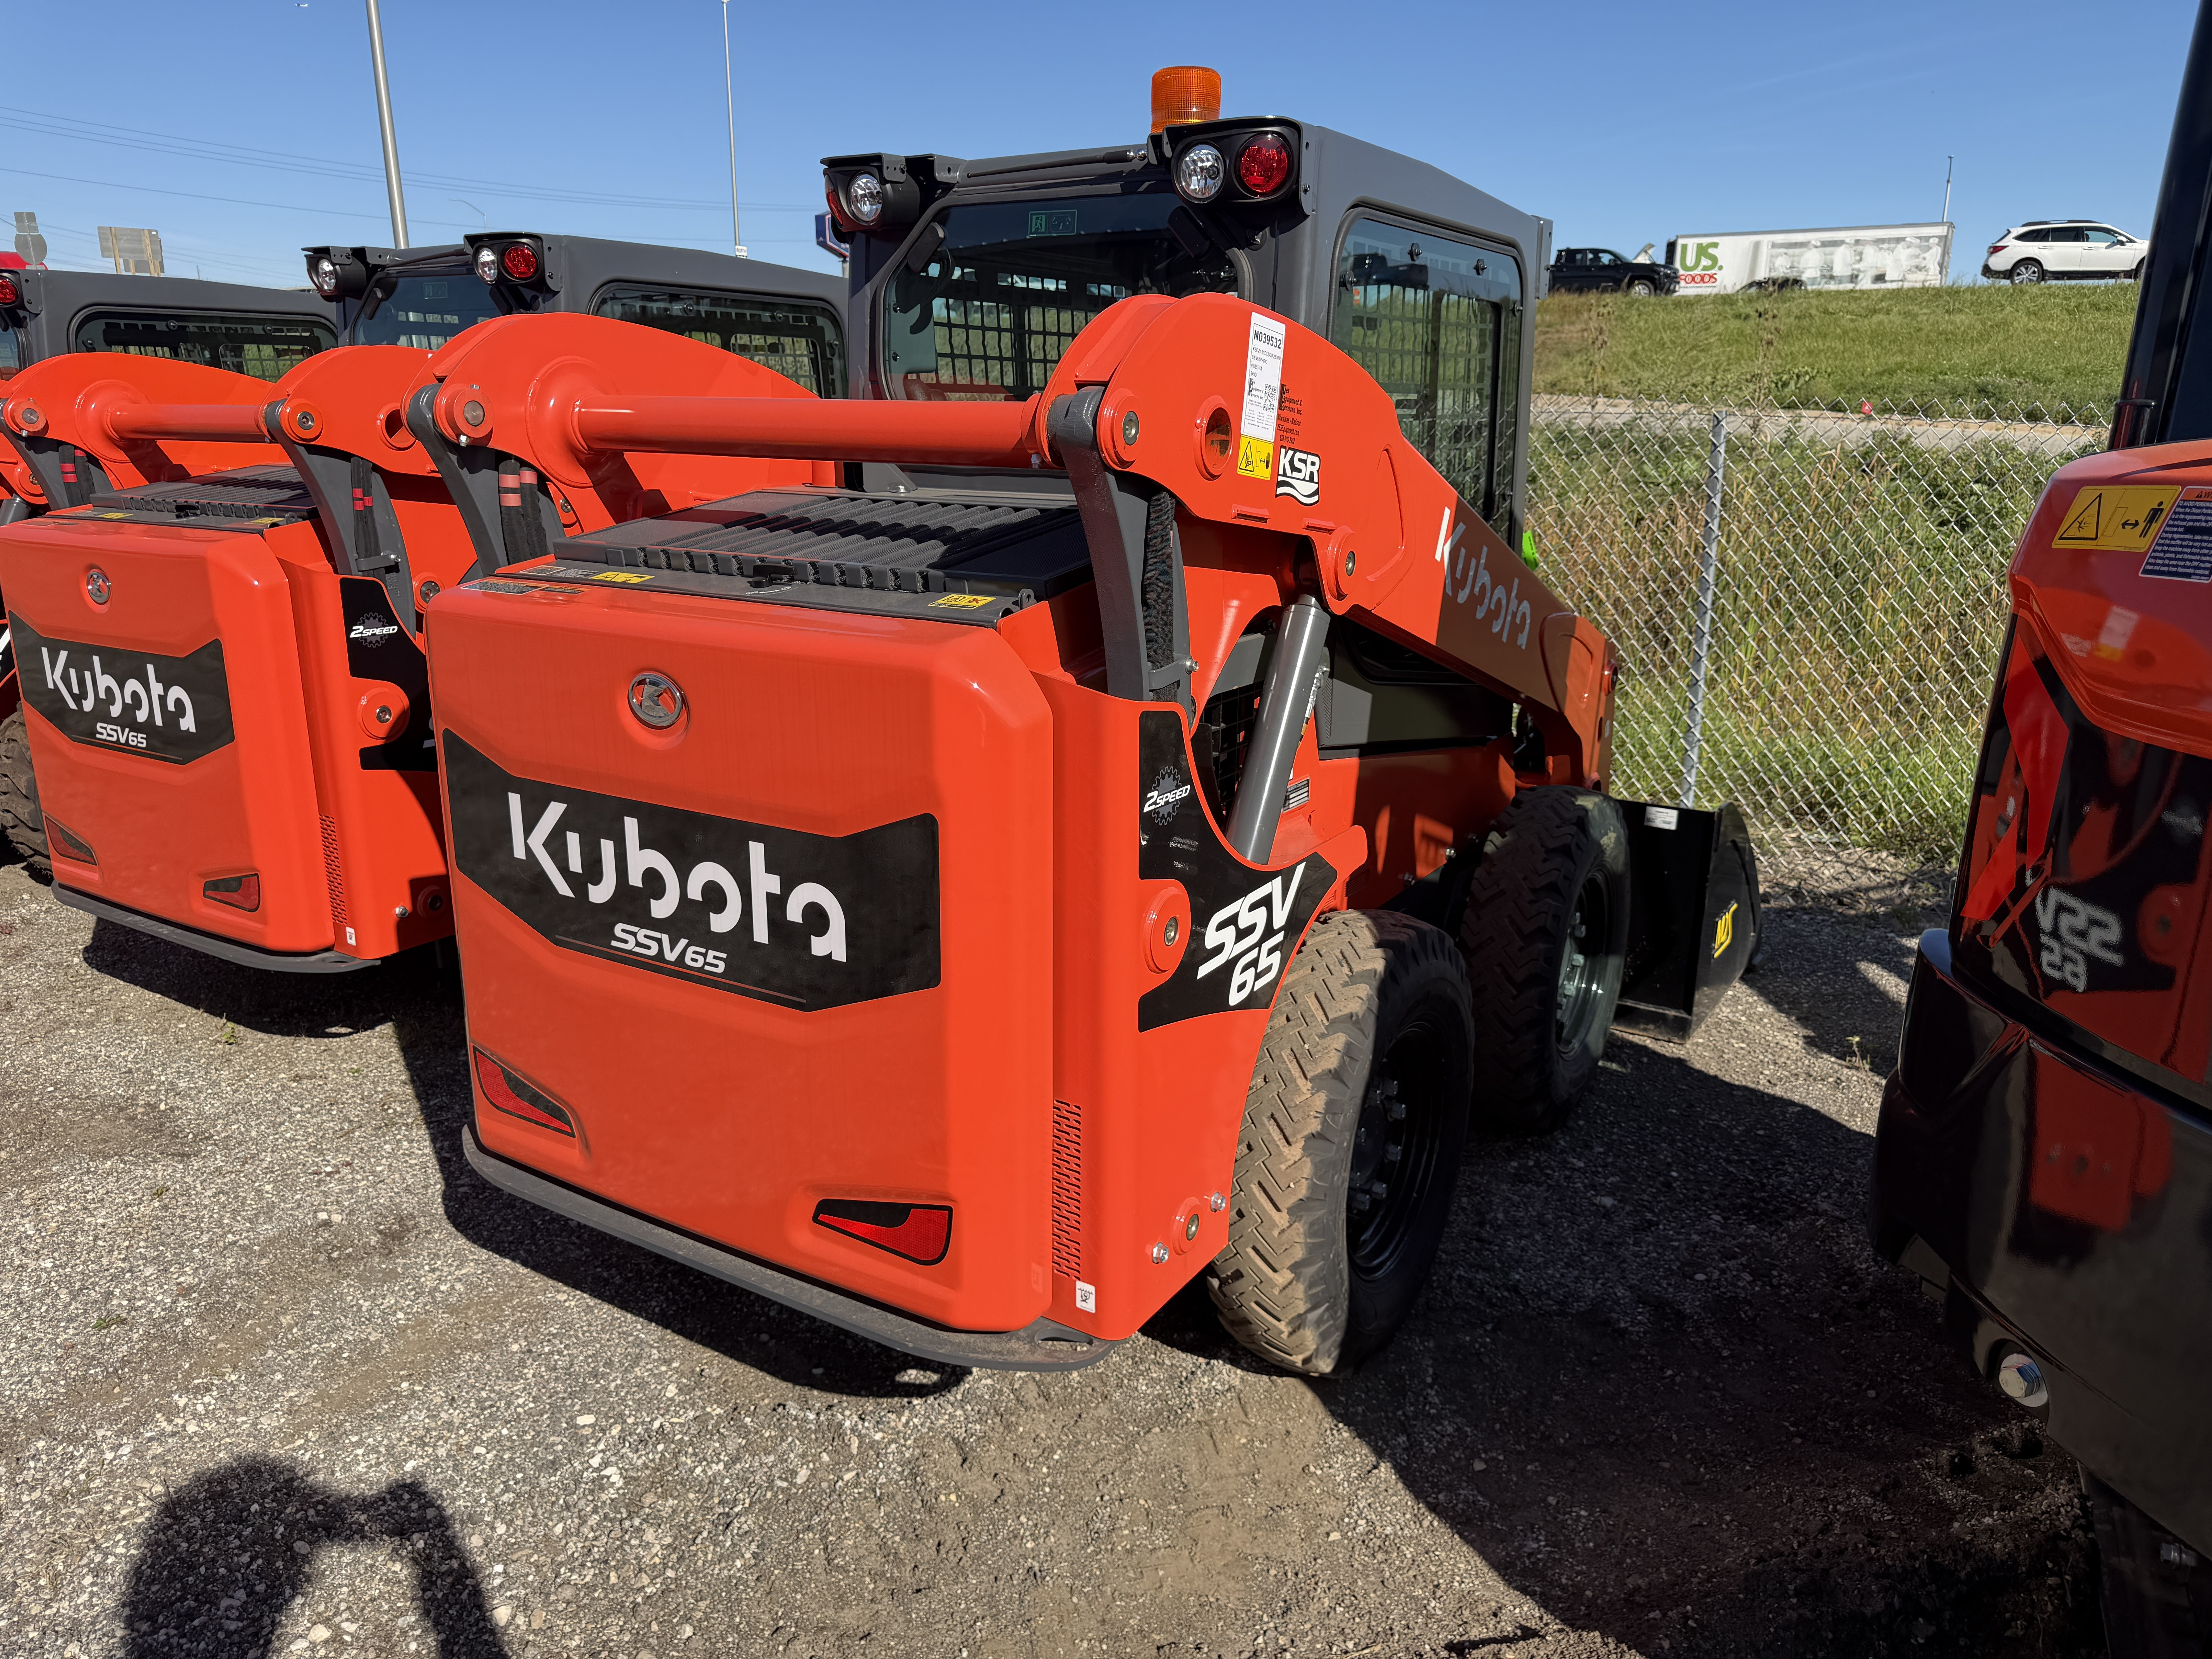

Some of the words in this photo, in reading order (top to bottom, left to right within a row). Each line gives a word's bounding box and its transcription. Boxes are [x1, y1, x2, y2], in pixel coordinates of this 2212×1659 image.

[1679, 273, 1717, 284] FOODS
[1254, 330, 1281, 349] N039532
[1278, 448, 1320, 483] KSR
[1435, 507, 1530, 649] Kubota
[350, 625, 398, 638] 2SPEED
[41, 647, 196, 733] Kubota
[96, 722, 147, 748] SSV65
[1143, 785, 1190, 813] 2SPEED
[508, 792, 847, 962] Kubota
[1197, 861, 1306, 980] SSV
[611, 923, 727, 974] SSV65
[1229, 931, 1285, 1006] 65
